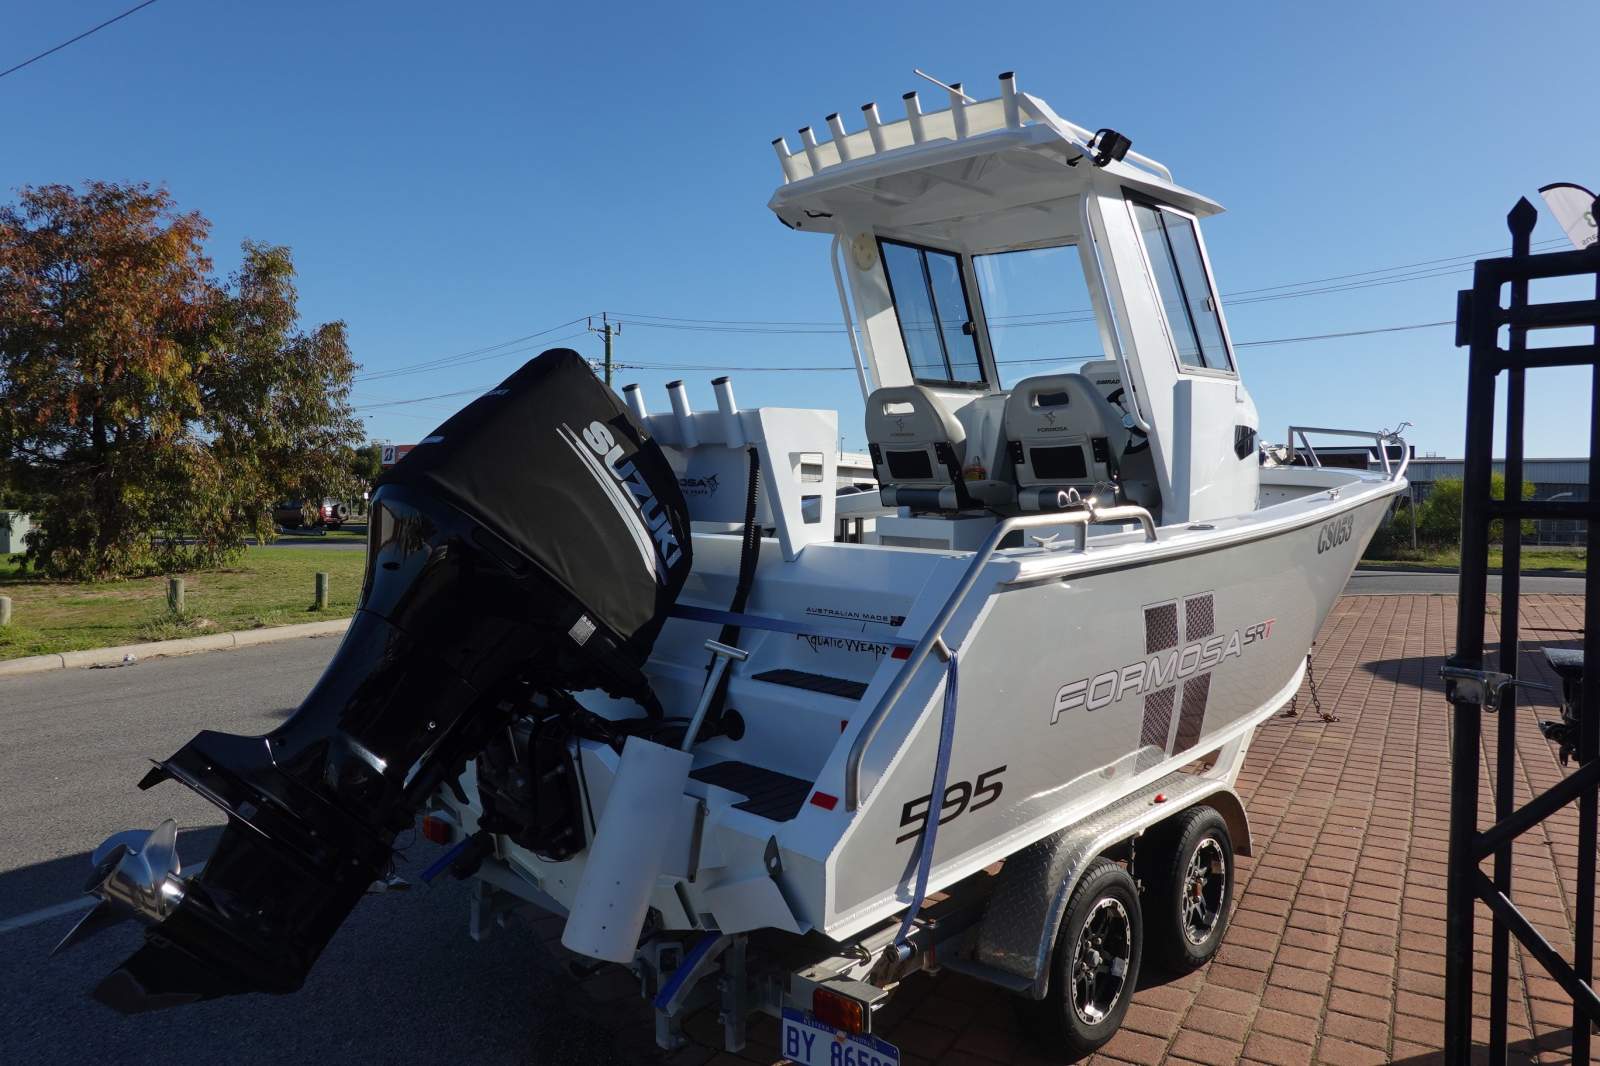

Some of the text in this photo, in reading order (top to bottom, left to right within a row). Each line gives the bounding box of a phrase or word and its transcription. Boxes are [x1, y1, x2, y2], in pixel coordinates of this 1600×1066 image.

[582, 420, 683, 569] SUZUKI
[805, 607, 889, 622] AUSTRALIAN MADE
[1049, 617, 1277, 726] FORMOSA SRT
[895, 765, 1008, 844] 595
[786, 1025, 816, 1063] BY
